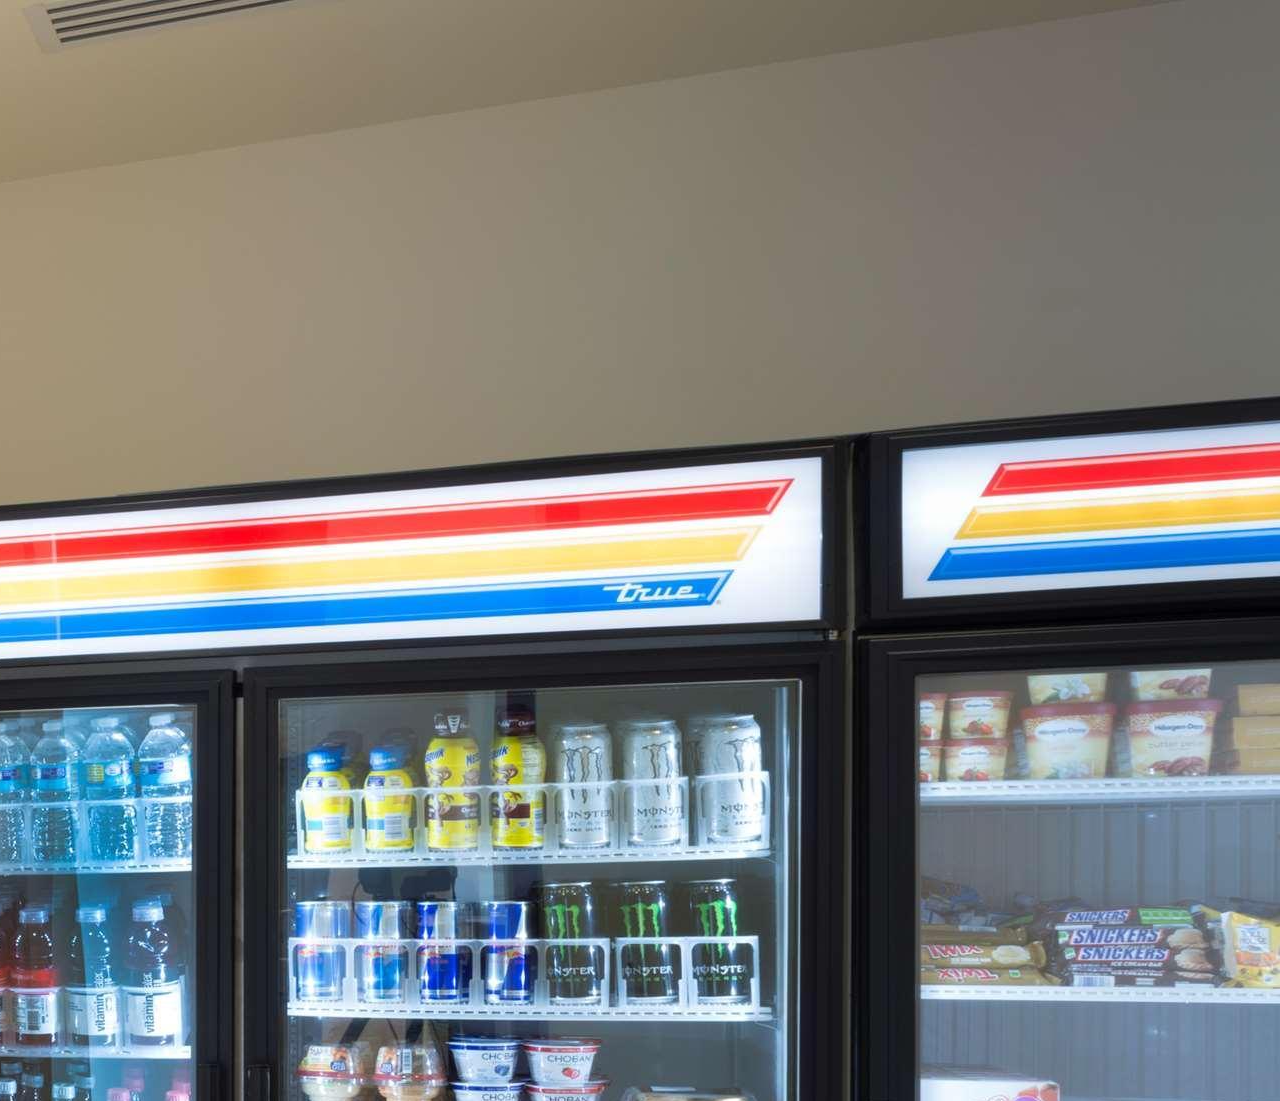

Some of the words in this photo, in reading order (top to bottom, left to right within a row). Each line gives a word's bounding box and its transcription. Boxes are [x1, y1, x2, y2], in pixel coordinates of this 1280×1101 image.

[1065, 910, 1129, 922] SNICKERS
[1072, 929, 1161, 945] SNICKERS
[1080, 947, 1170, 961] SNICKERS
